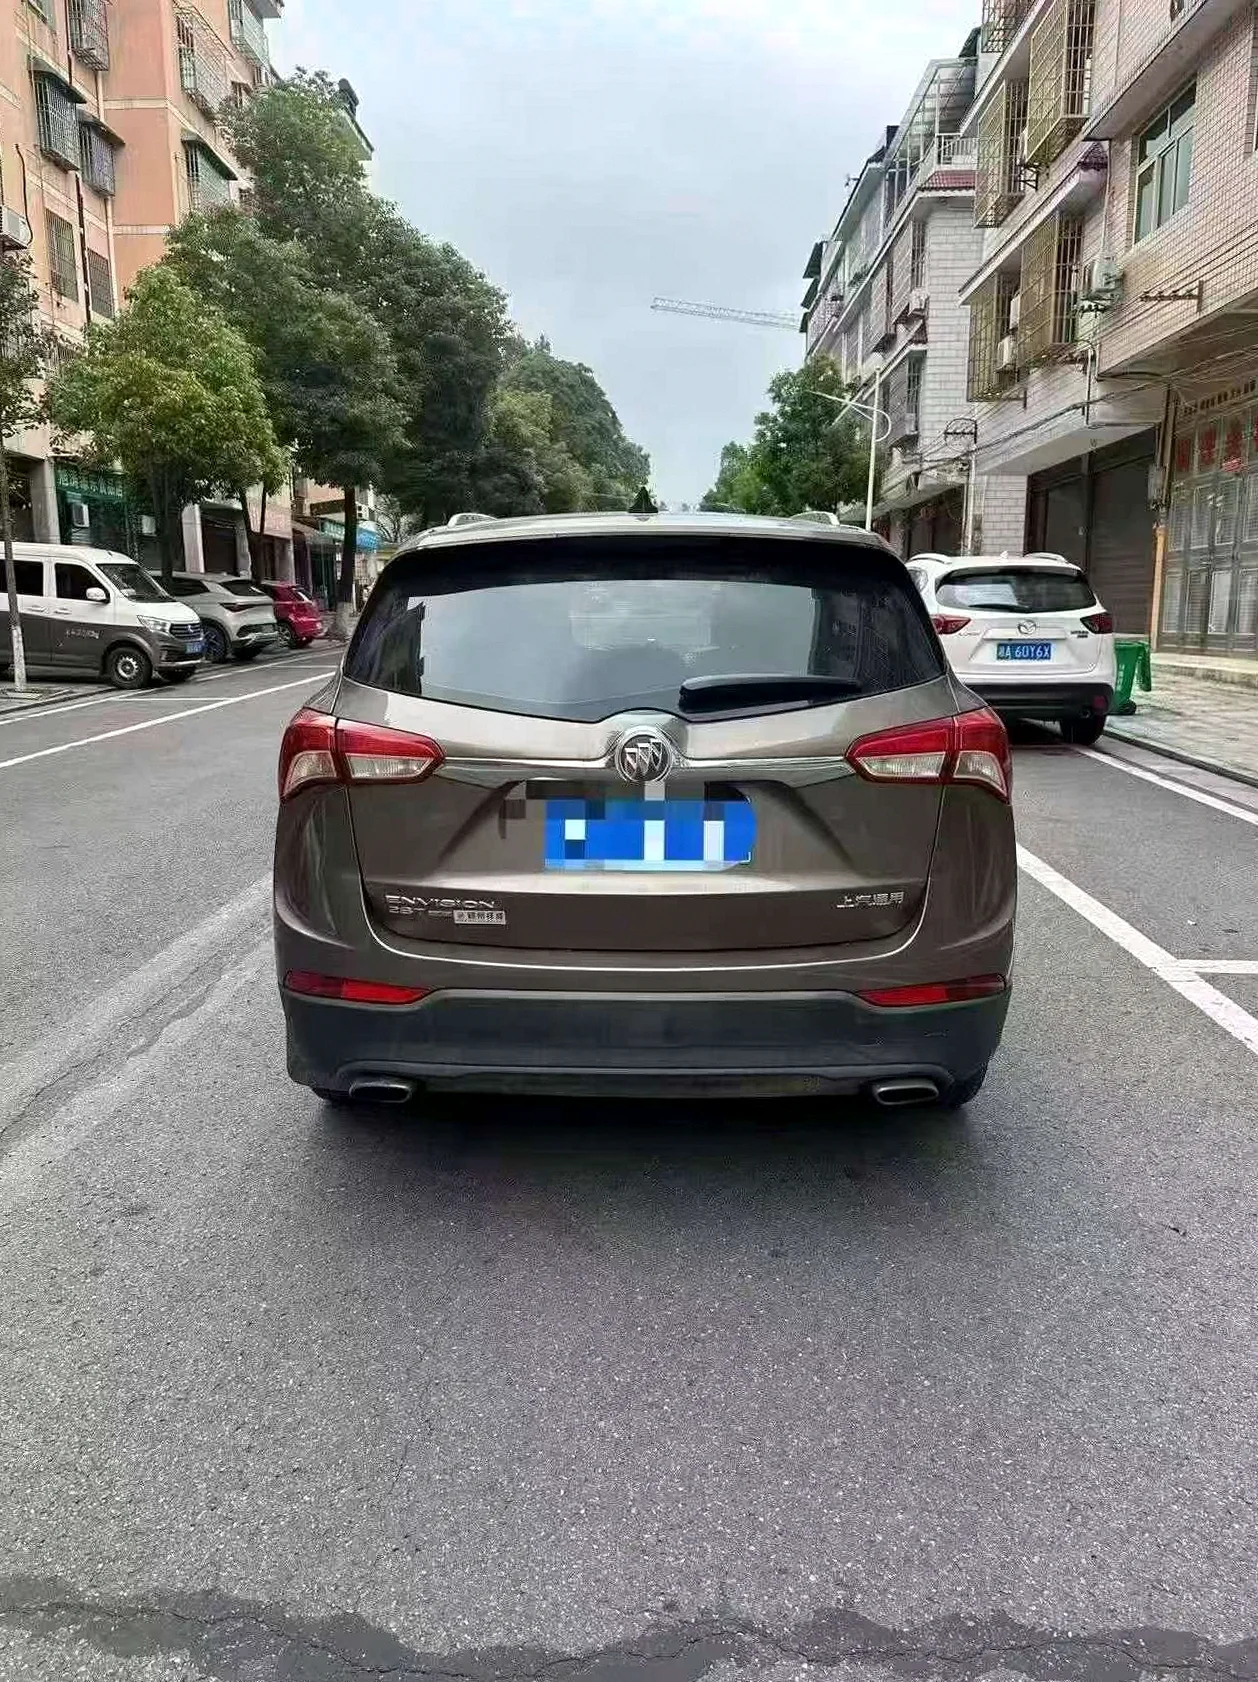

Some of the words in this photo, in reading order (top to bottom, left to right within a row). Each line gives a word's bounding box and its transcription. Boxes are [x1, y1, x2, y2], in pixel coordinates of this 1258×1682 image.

[384, 895, 495, 908] ENVISION
[836, 892, 904, 908] 上汽通用
